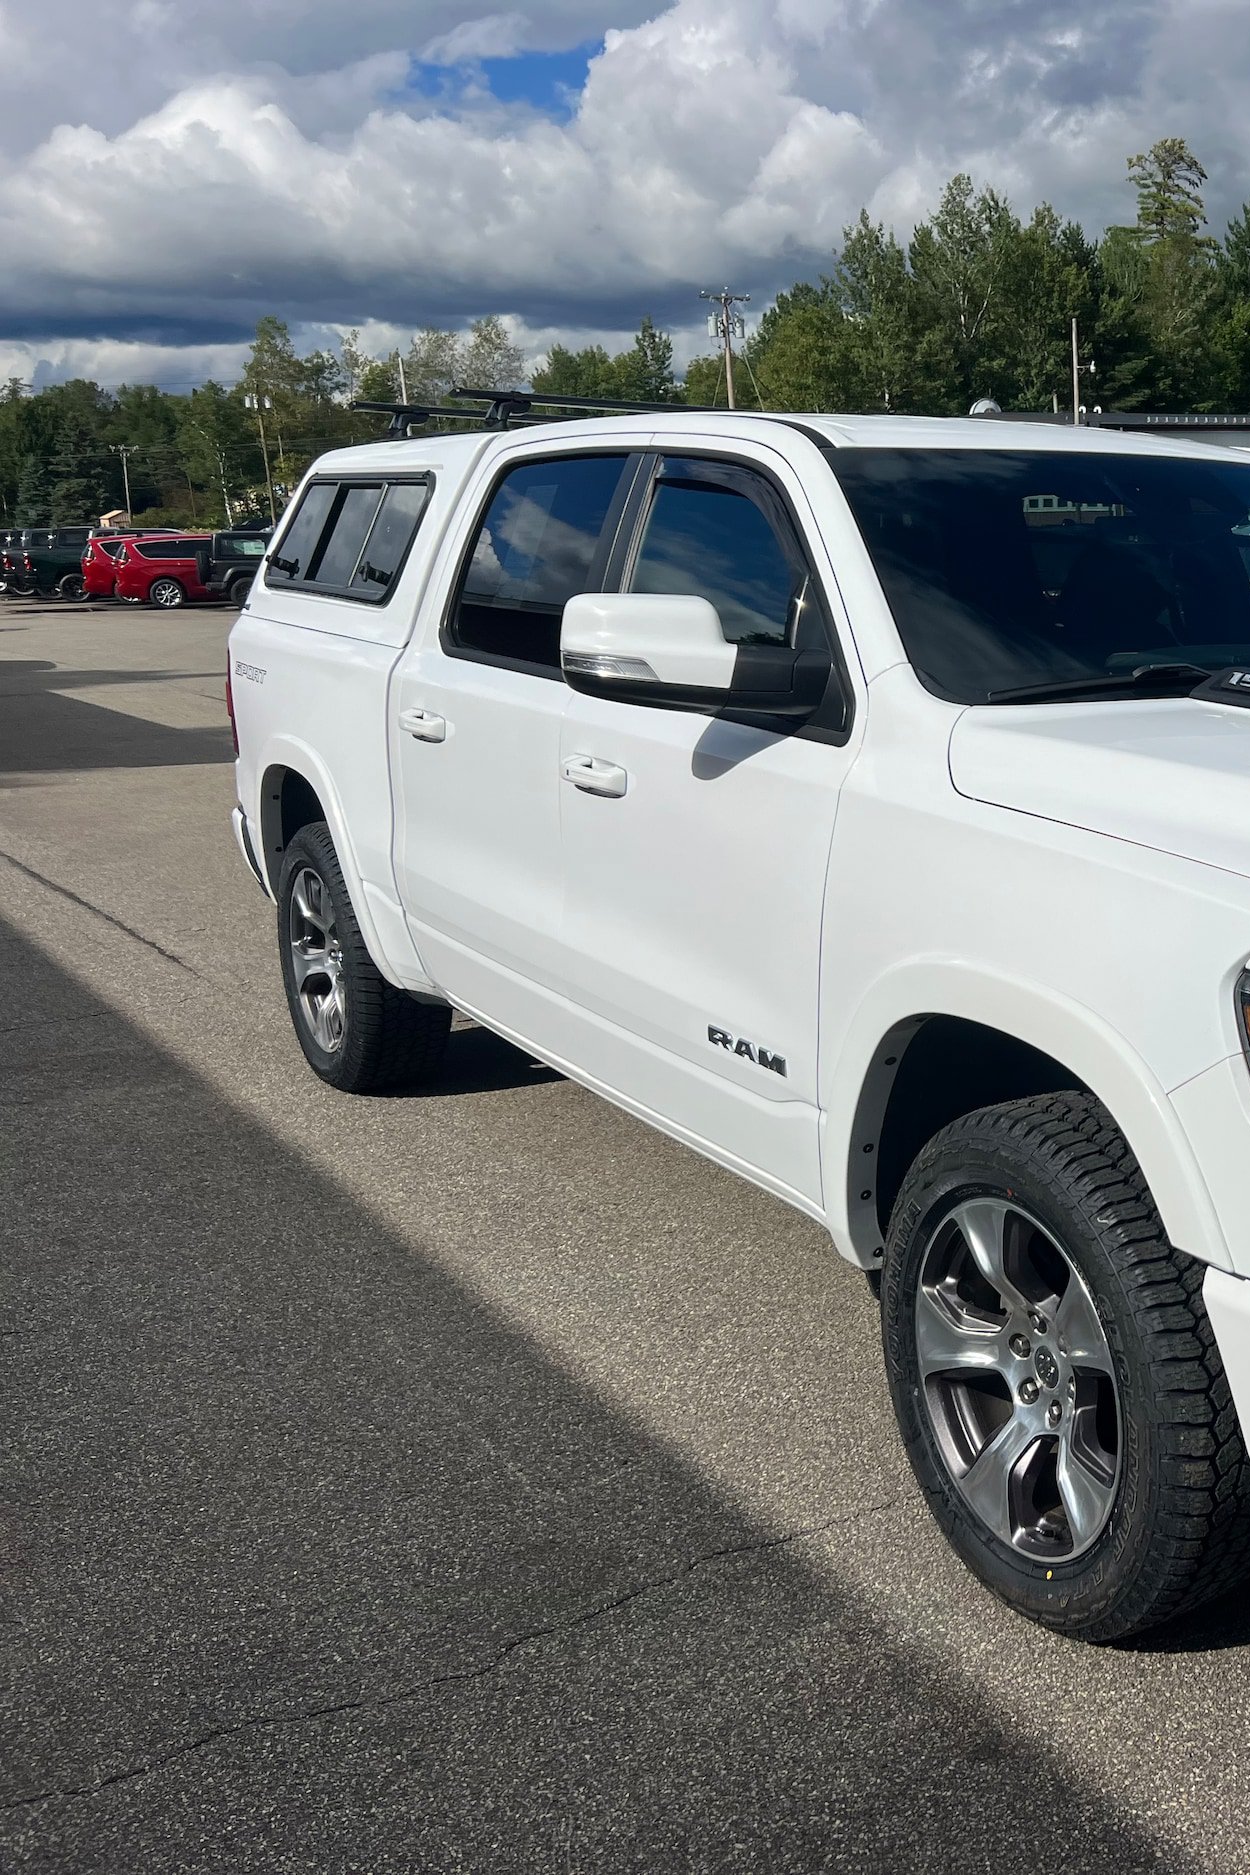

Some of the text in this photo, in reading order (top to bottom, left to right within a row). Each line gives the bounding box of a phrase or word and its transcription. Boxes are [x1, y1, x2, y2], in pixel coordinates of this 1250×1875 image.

[235, 660, 267, 685] SPORT
[707, 1023, 788, 1079] RAM
[885, 1199, 921, 1384] YOKOHAMA
